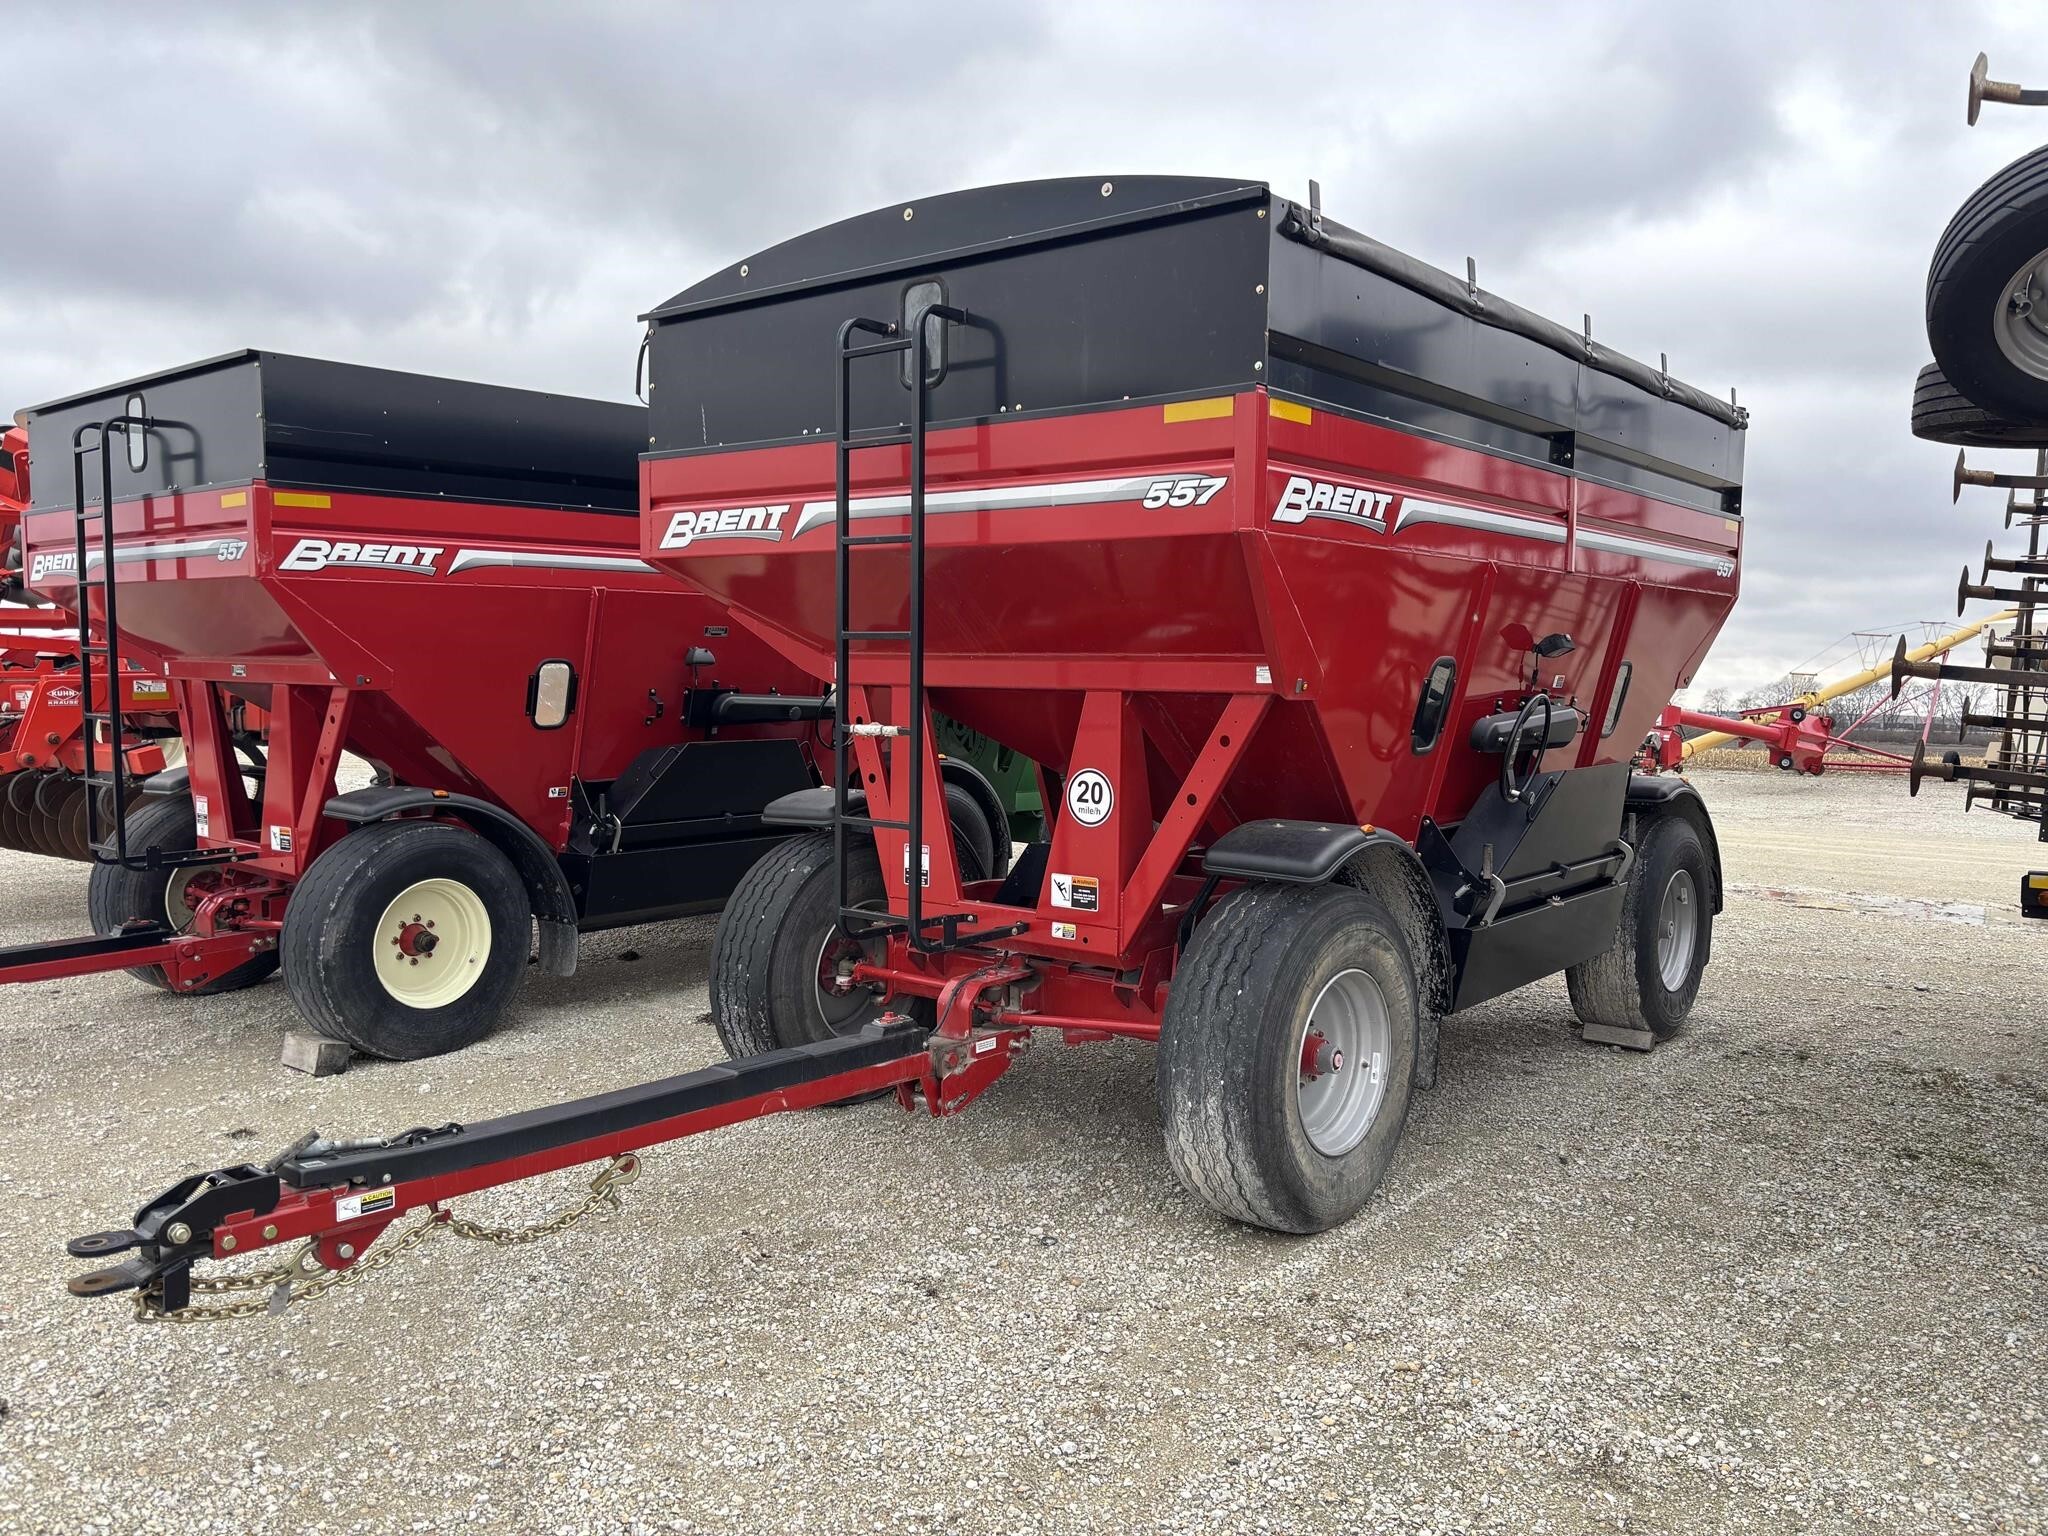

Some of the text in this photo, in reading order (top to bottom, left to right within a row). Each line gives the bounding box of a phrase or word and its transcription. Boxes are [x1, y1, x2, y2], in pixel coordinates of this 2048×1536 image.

[1142, 475, 1229, 510] 557
[1271, 475, 1393, 525] BRENT
[658, 503, 792, 550] BRENT
[217, 541, 249, 561] 557
[279, 538, 445, 571] BRENT
[1716, 561, 1735, 578] 557
[1076, 780, 1104, 805] 20
[1078, 806, 1101, 816] mile/h
[367, 1190, 393, 1201] CAUTION
